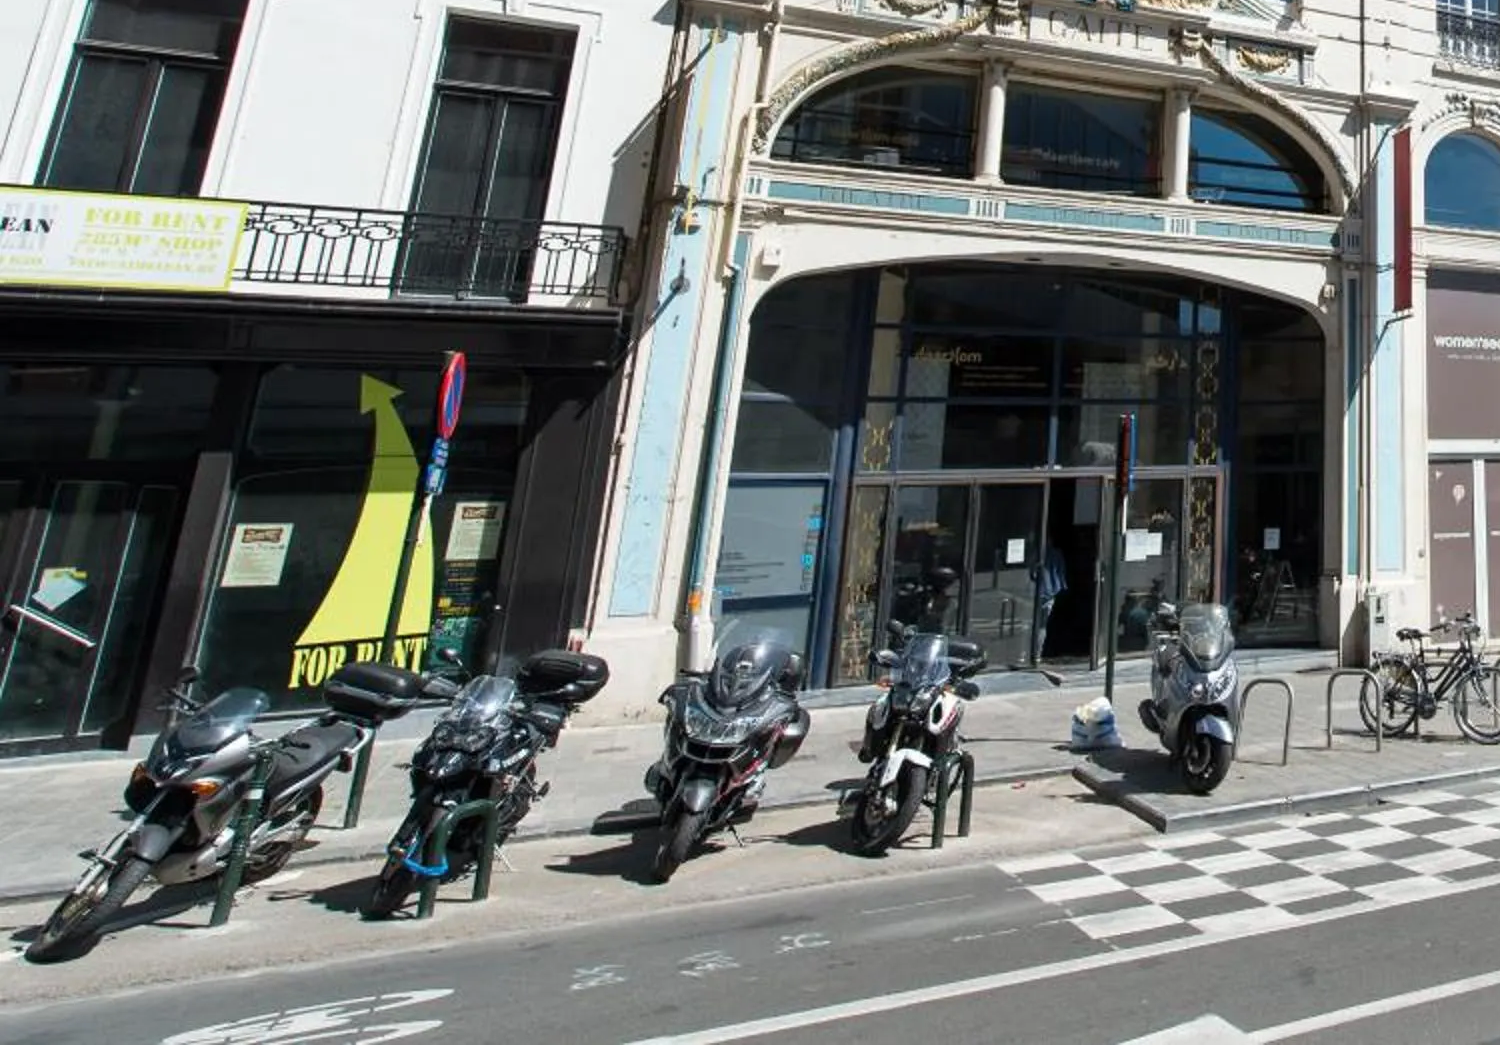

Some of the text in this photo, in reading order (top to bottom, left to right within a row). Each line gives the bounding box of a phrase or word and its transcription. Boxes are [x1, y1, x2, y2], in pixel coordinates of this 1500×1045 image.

[84, 207, 229, 231] FOR RENT
[288, 644, 347, 689] FOR
